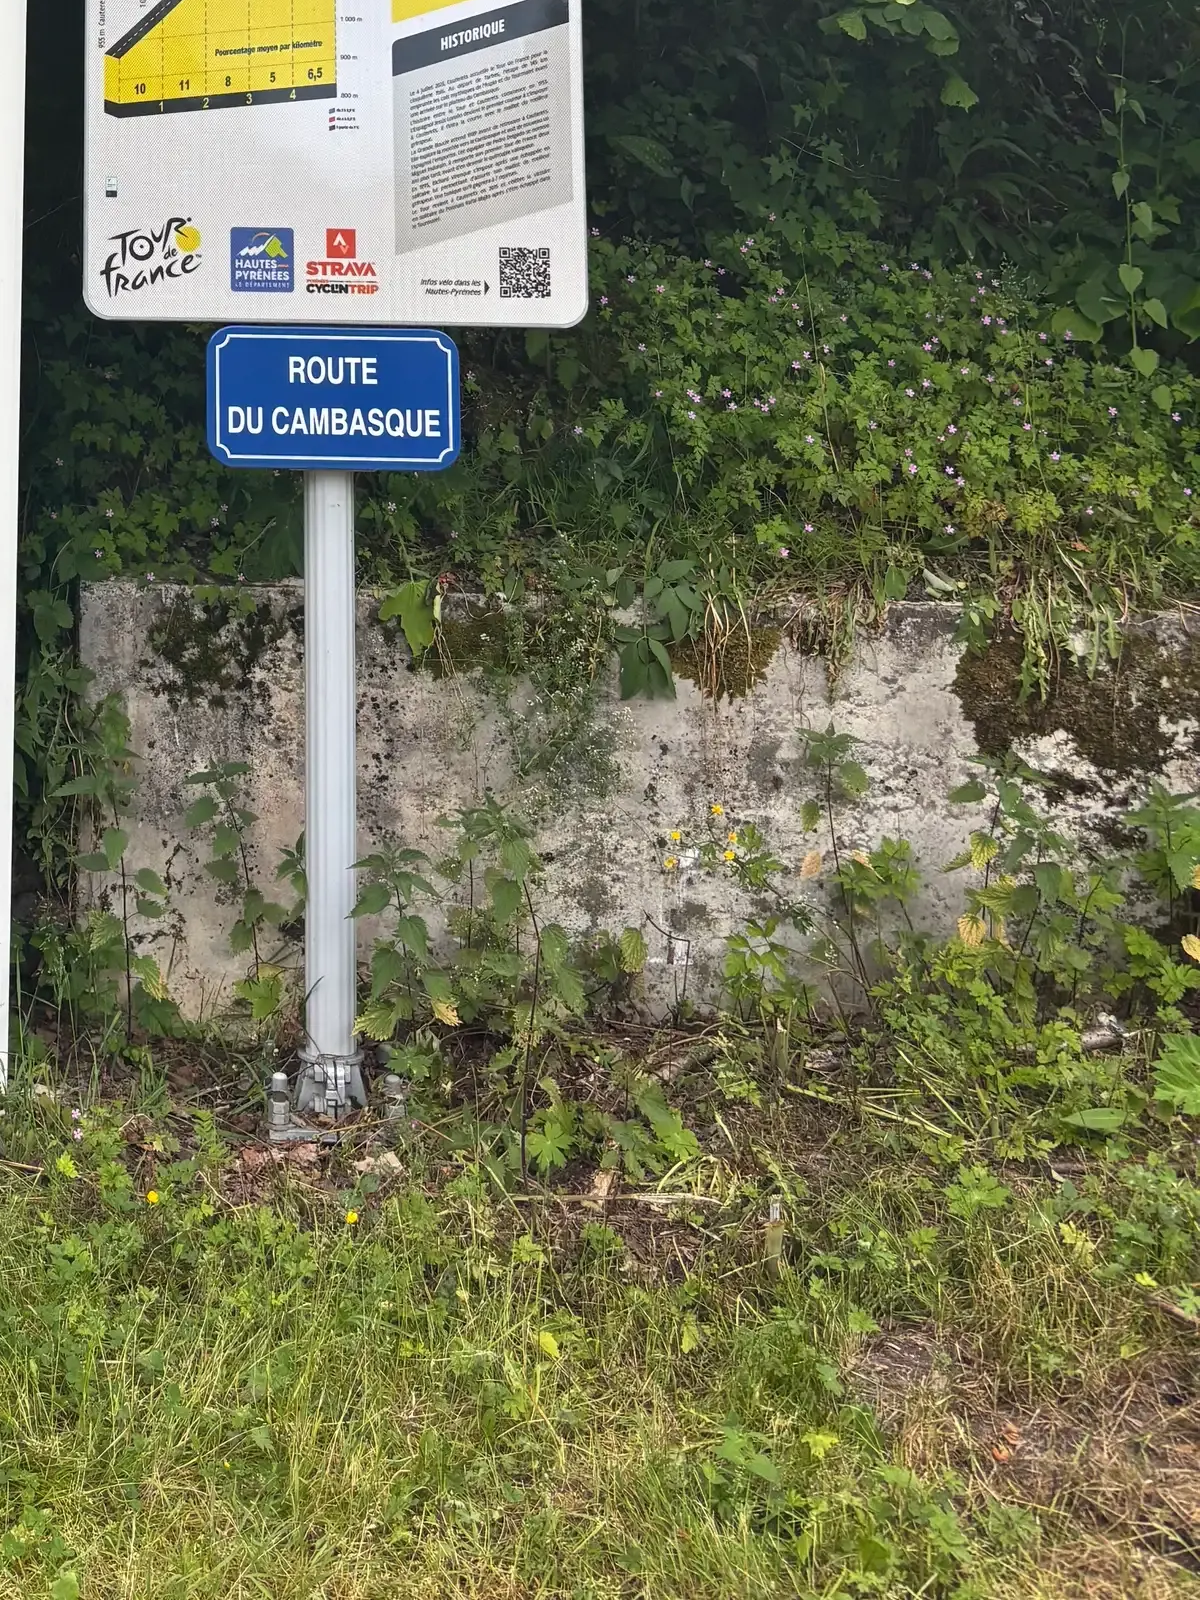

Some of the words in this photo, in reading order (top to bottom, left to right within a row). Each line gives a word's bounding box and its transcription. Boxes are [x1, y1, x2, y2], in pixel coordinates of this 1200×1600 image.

[440, 19, 505, 51] HISTORIQUE
[215, 47, 255, 56] Pourcentage
[257, 44, 278, 53] moyen
[280, 43, 291, 52] par
[134, 83, 146, 95] 10
[179, 80, 190, 90] 11
[225, 76, 231, 87] 8
[270, 72, 276, 83] 5
[308, 67, 323, 82] 6,5
[159, 102, 164, 112] 1
[203, 98, 209, 109] 2
[246, 93, 252, 105] 3
[289, 89, 296, 100] 4
[163, 245, 177, 259] de
[306, 261, 376, 276] STRAVA
[420, 278, 437, 286] Infos
[289, 356, 378, 385] ROUTE
[228, 406, 263, 434] DU
[272, 406, 441, 438] CAMBASQUE
